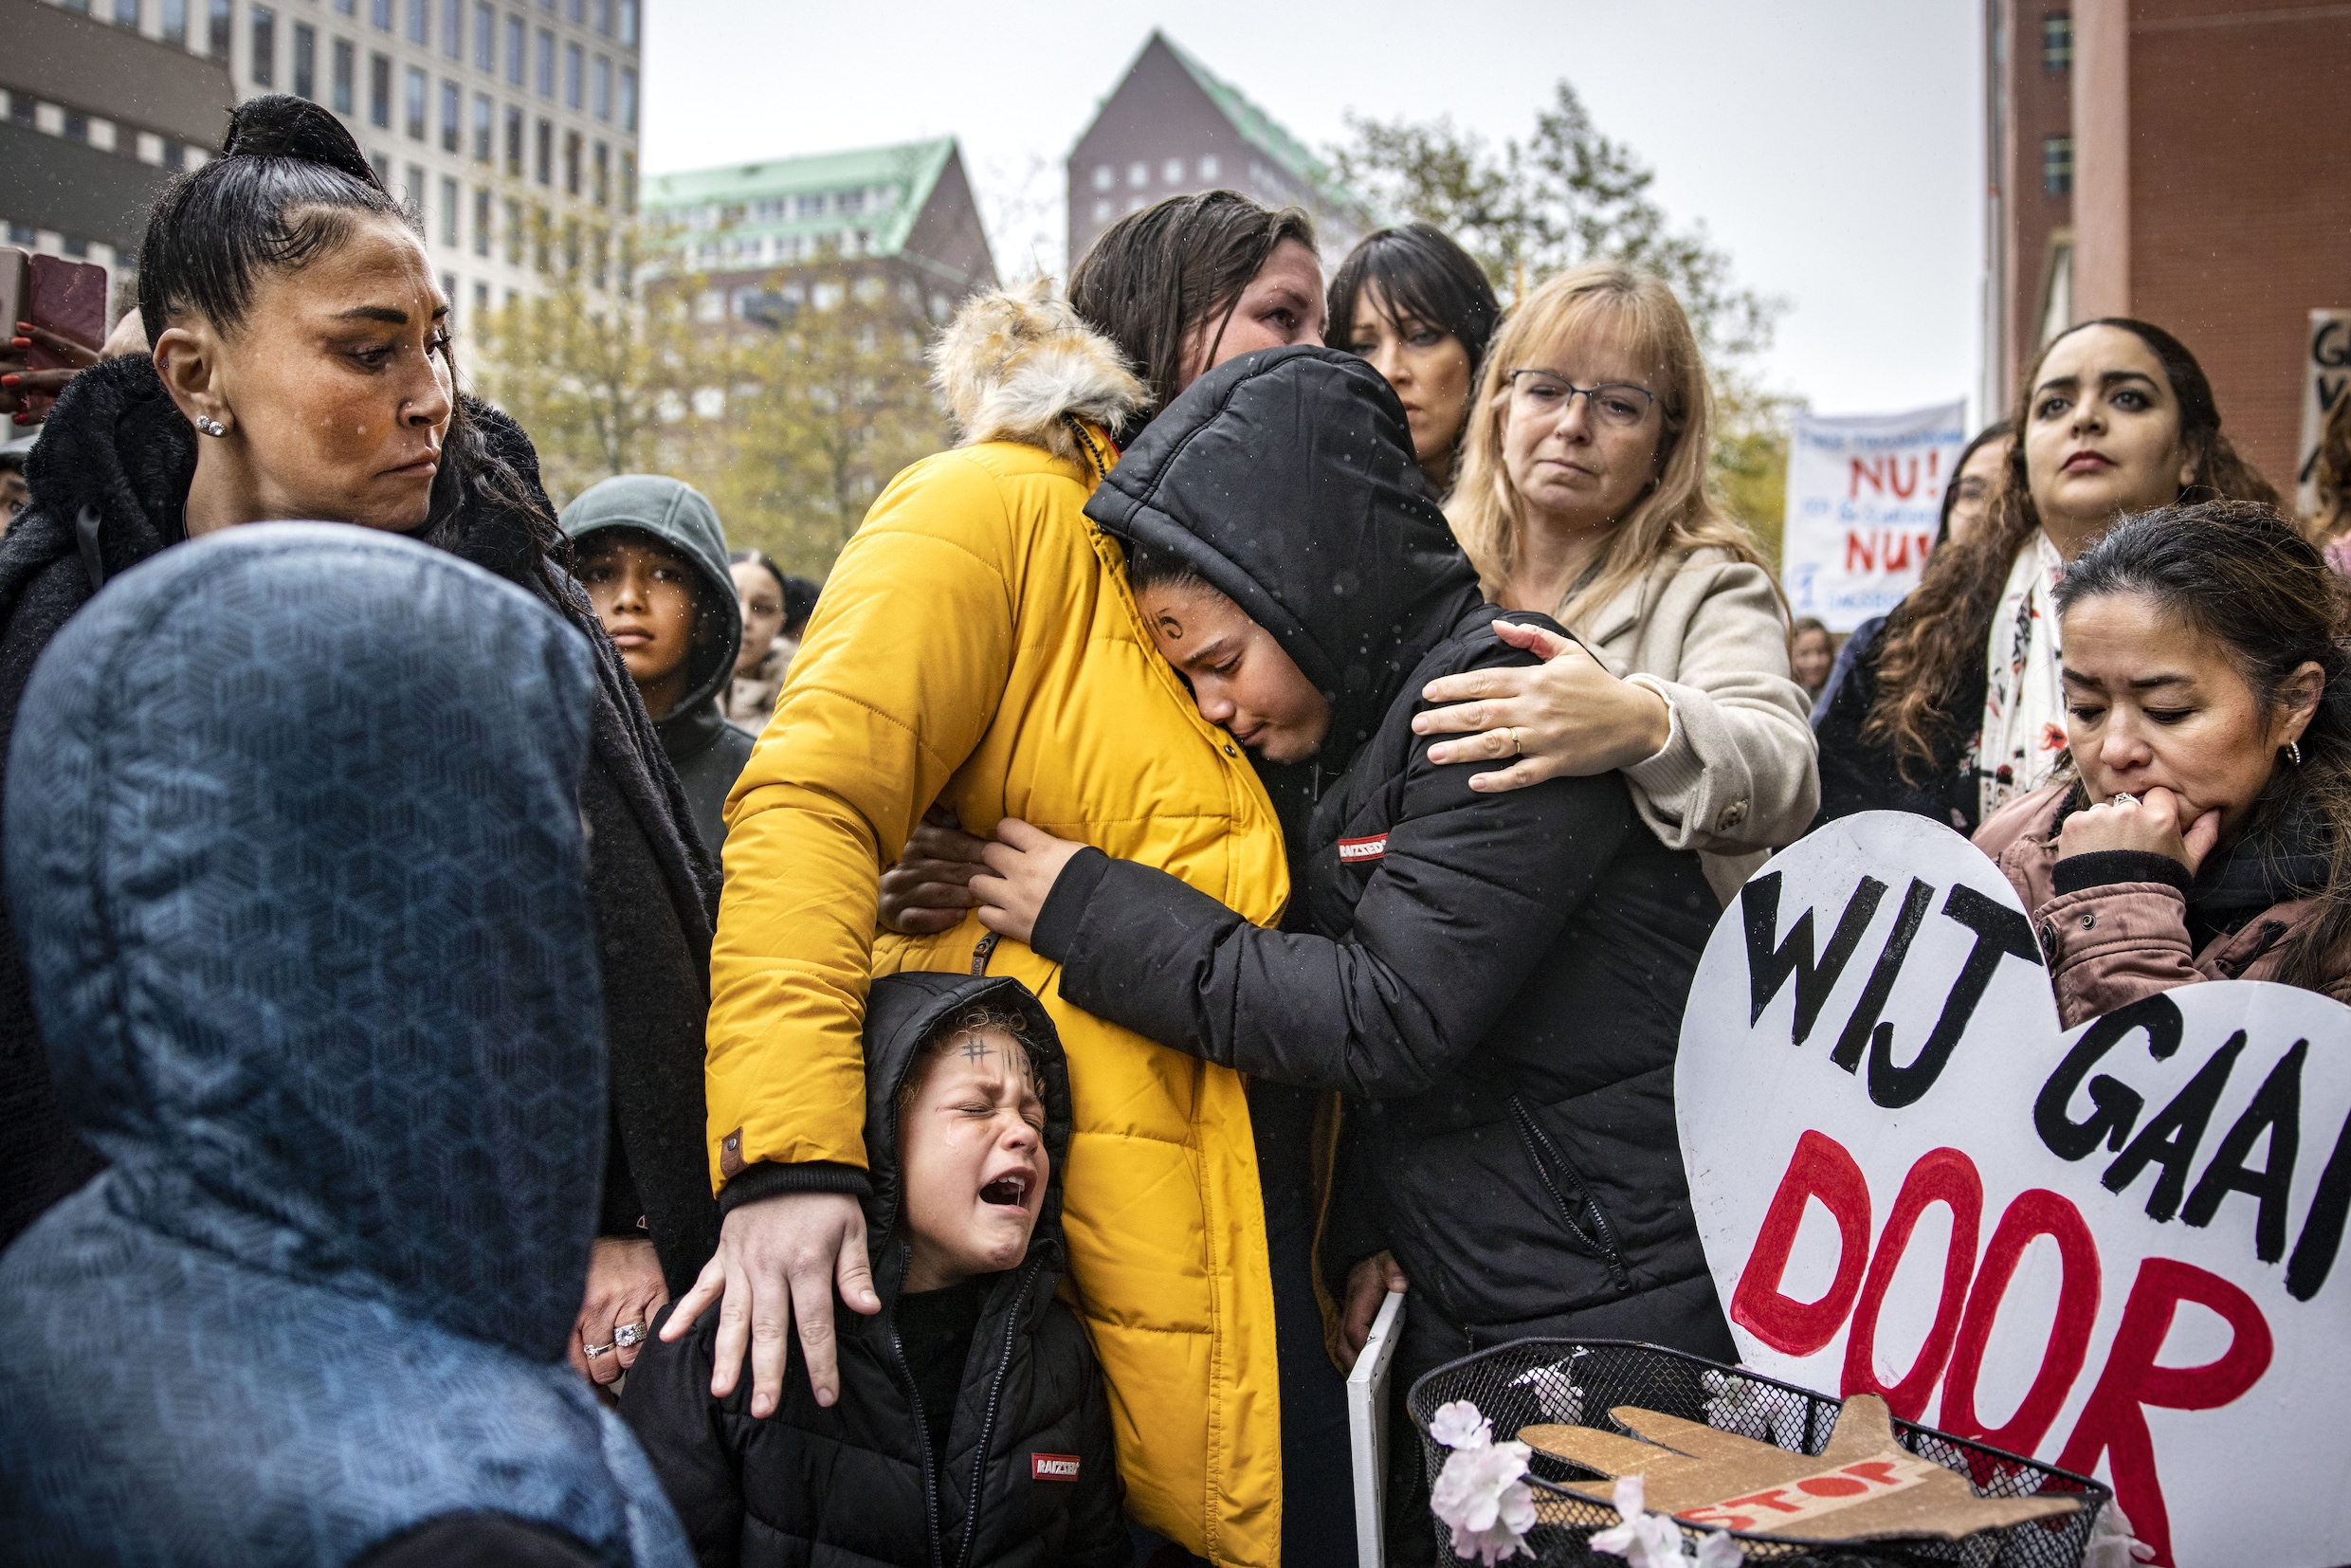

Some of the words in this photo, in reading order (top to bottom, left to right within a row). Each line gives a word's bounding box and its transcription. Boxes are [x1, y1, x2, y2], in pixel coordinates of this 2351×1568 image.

[1850, 447, 1938, 501] NU!
[1740, 870, 2045, 1109] WIJ
[1730, 1129, 2273, 1568] DOOR
[1674, 1462, 1904, 1532] STOP
